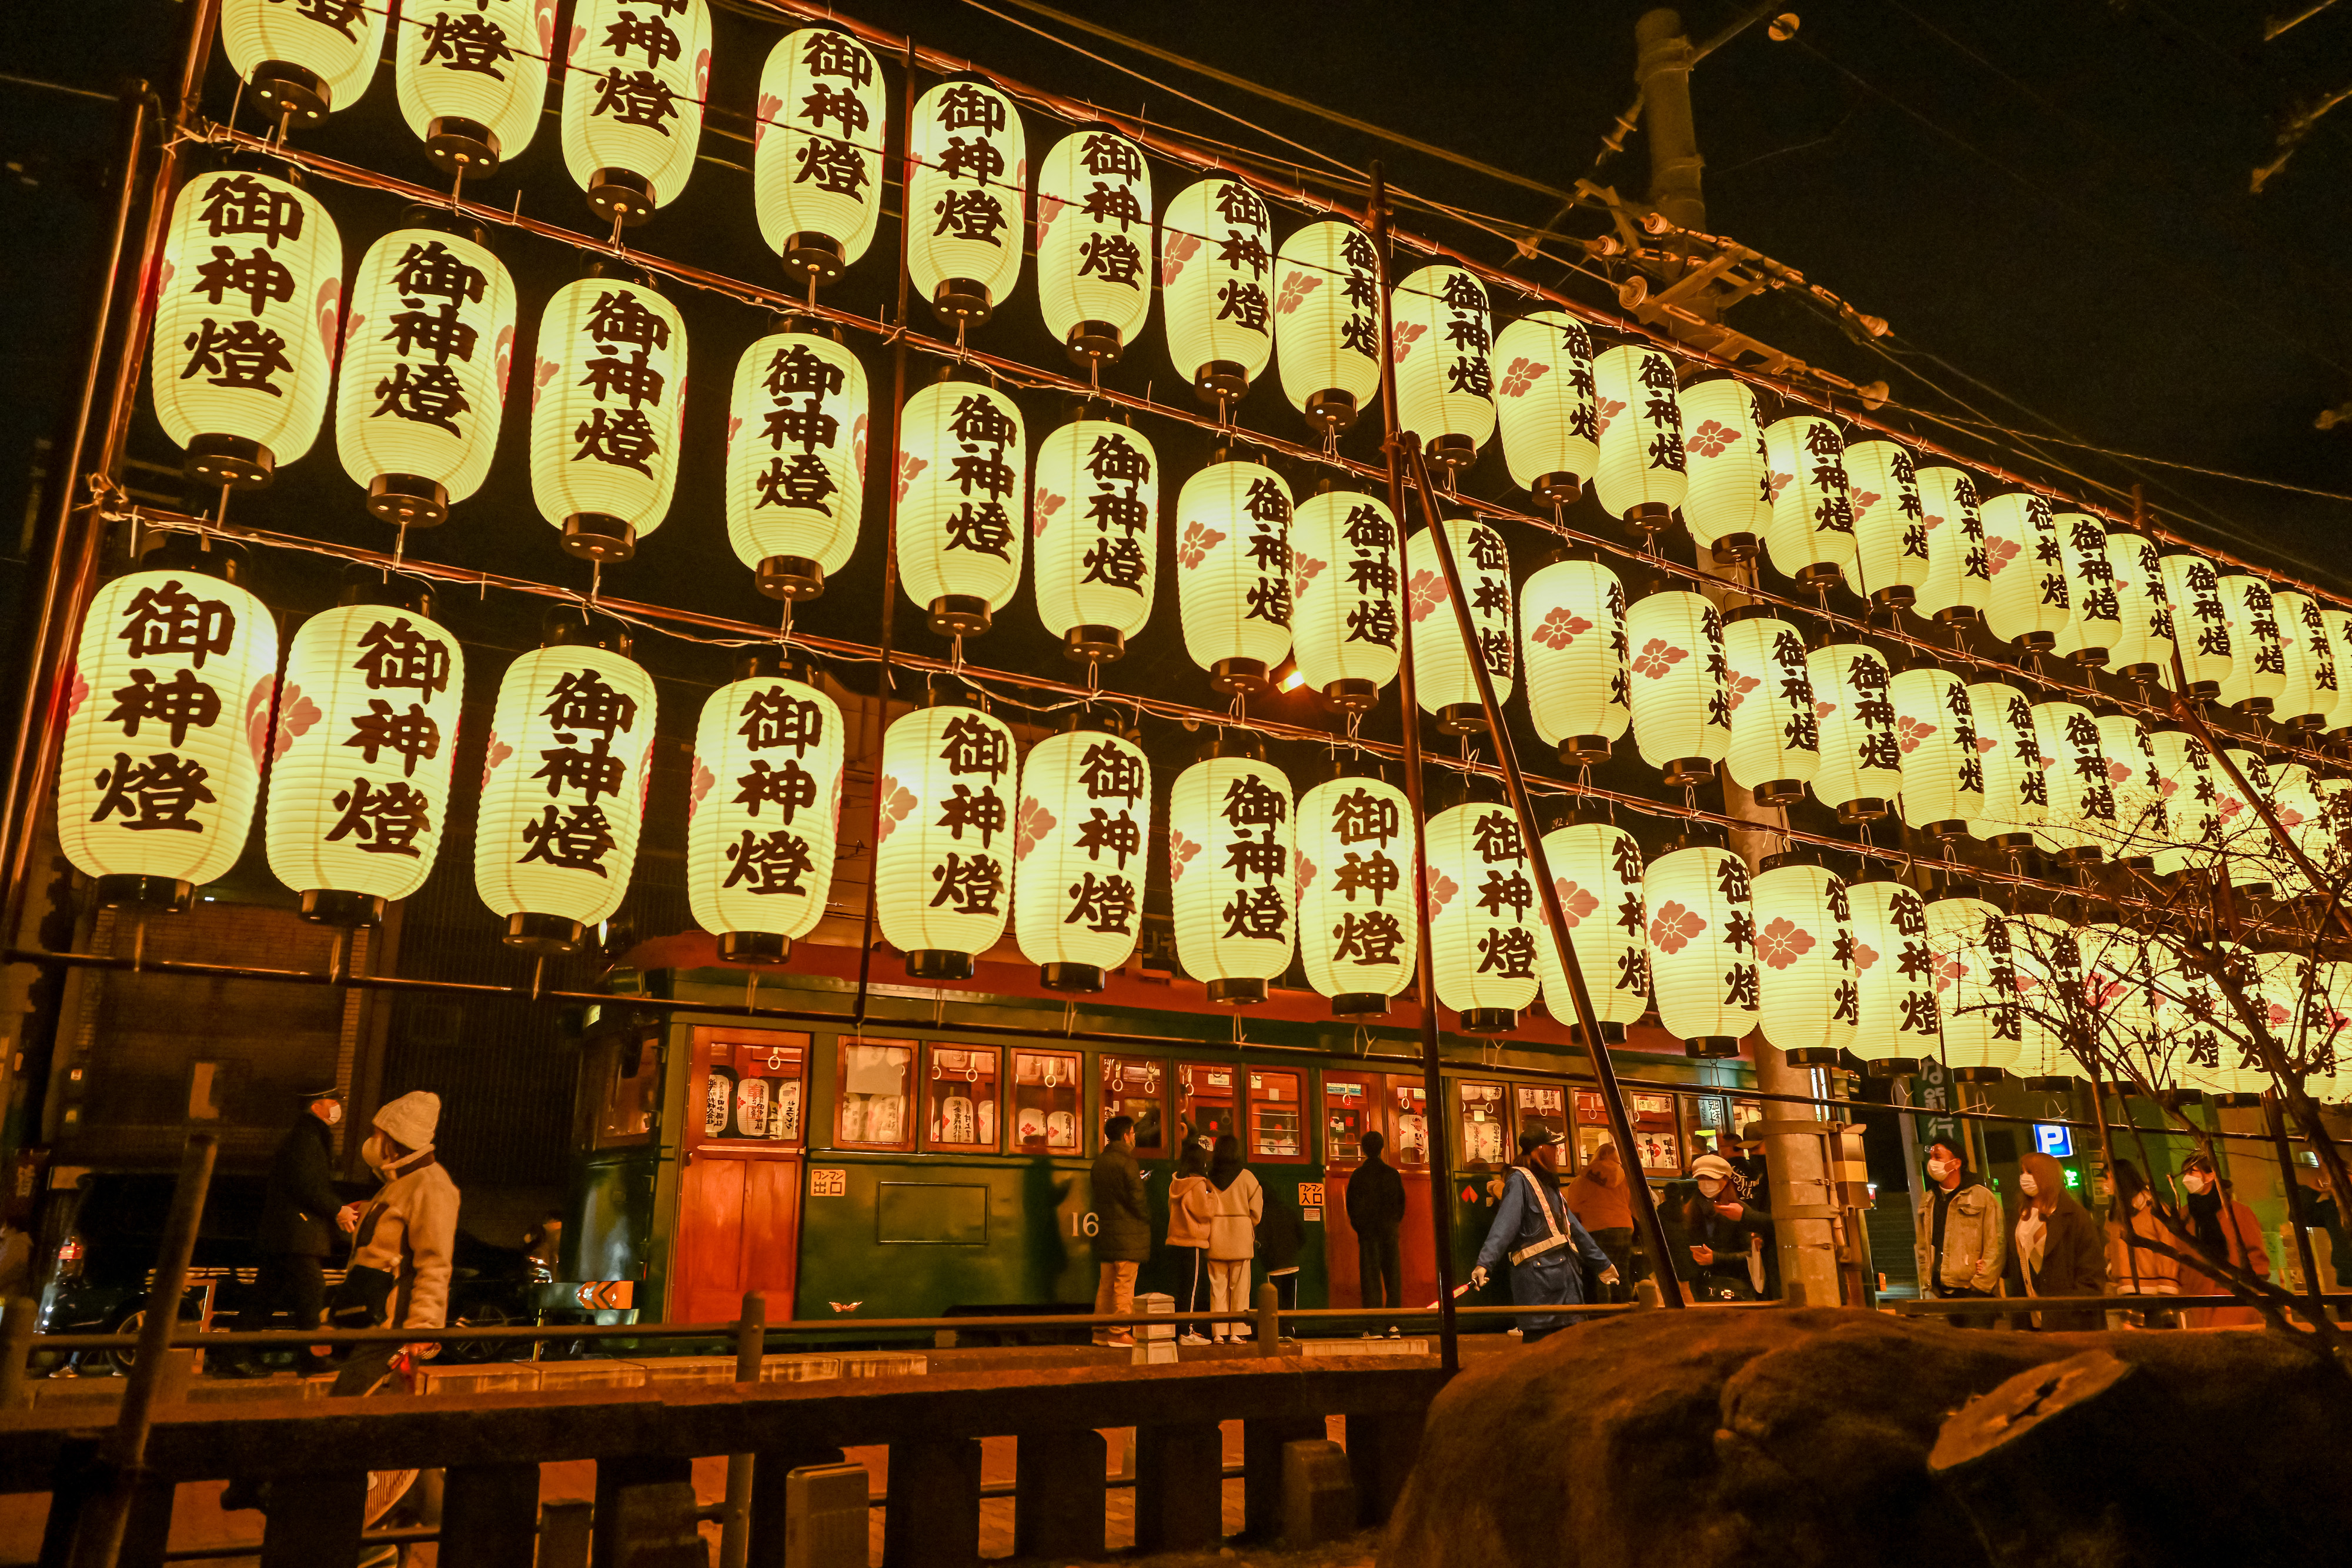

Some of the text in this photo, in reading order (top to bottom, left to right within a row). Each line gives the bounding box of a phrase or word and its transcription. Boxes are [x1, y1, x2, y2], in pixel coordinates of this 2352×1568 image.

[593, 0, 688, 137] 神燈
[796, 32, 873, 203] 御神燈
[933, 83, 1008, 248] 御神燈
[1077, 133, 1144, 292] 御神燈
[180, 174, 305, 398] 御神燈
[1216, 183, 1272, 339] 御神燈
[1339, 230, 1380, 372] 御神燈
[369, 241, 489, 439] 御神燈
[570, 290, 671, 481] 御神燈
[1440, 273, 1494, 407] 御神燈
[1638, 353, 1687, 476] 御神燈
[754, 344, 844, 517] 御神燈
[943, 394, 1017, 565] 御神燈
[1805, 422, 1855, 537] 御神燈
[1080, 433, 1151, 598] 御神燈
[1244, 477, 1294, 634] 御神燈
[1342, 504, 1399, 654] 御神燈
[2070, 520, 2120, 623] 御神燈
[1468, 527, 1514, 679] 御神燈
[2186, 562, 2231, 657] 御神燈
[2243, 583, 2286, 676] 御神燈
[90, 580, 236, 834] 御神燈
[324, 617, 452, 859] 御神燈
[516, 669, 638, 879] 御神燈
[1847, 654, 1902, 774] 御神燈
[2065, 713, 2116, 820] 御神燈
[722, 686, 823, 897] 御神燈
[929, 714, 1010, 917] 御神燈
[1064, 740, 1144, 937] 御神燈
[1221, 774, 1289, 945] 御神燈
[1332, 787, 1405, 966] 御神燈
[1472, 810, 1539, 979] 御神燈
[1889, 889, 1940, 1035] 御神燈
[814, 1171, 843, 1180] ワンマン
[814, 1182, 842, 1194] 出口
[1301, 1193, 1322, 1204] 入口
[2039, 1126, 2064, 1154] P
[1072, 1212, 1099, 1237] 16
